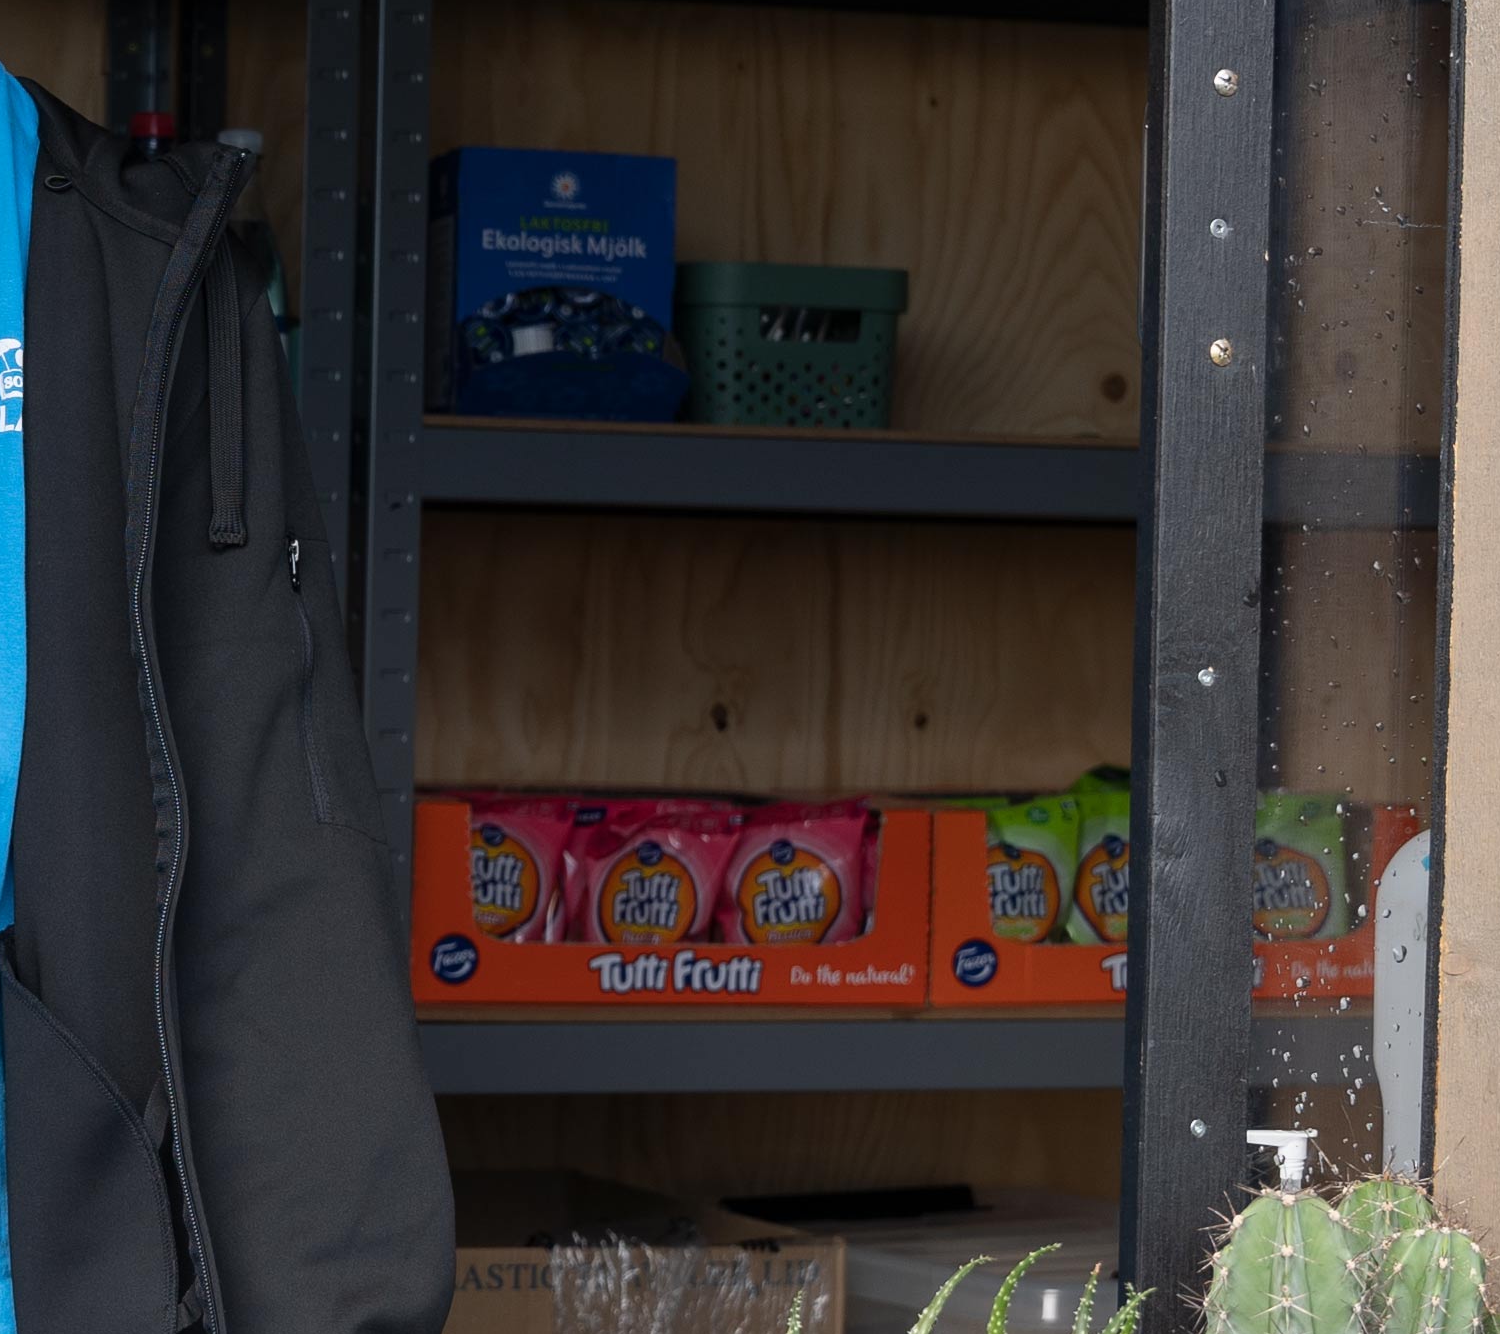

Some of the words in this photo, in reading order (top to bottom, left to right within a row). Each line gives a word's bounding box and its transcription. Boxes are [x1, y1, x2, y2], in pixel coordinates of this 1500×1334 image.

[481, 227, 584, 259] Ekologisk
[586, 232, 648, 262] Mjölk
[619, 868, 682, 901] Tutti
[756, 867, 822, 898] Tutti
[613, 890, 679, 929] Frutti
[754, 893, 826, 926] Frutti
[430, 942, 478, 973] Fazer
[589, 952, 668, 992] Tutti
[673, 949, 763, 994] Frutti
[790, 966, 813, 986] Do
[816, 964, 842, 986] the
[954, 947, 998, 977] Fazer
